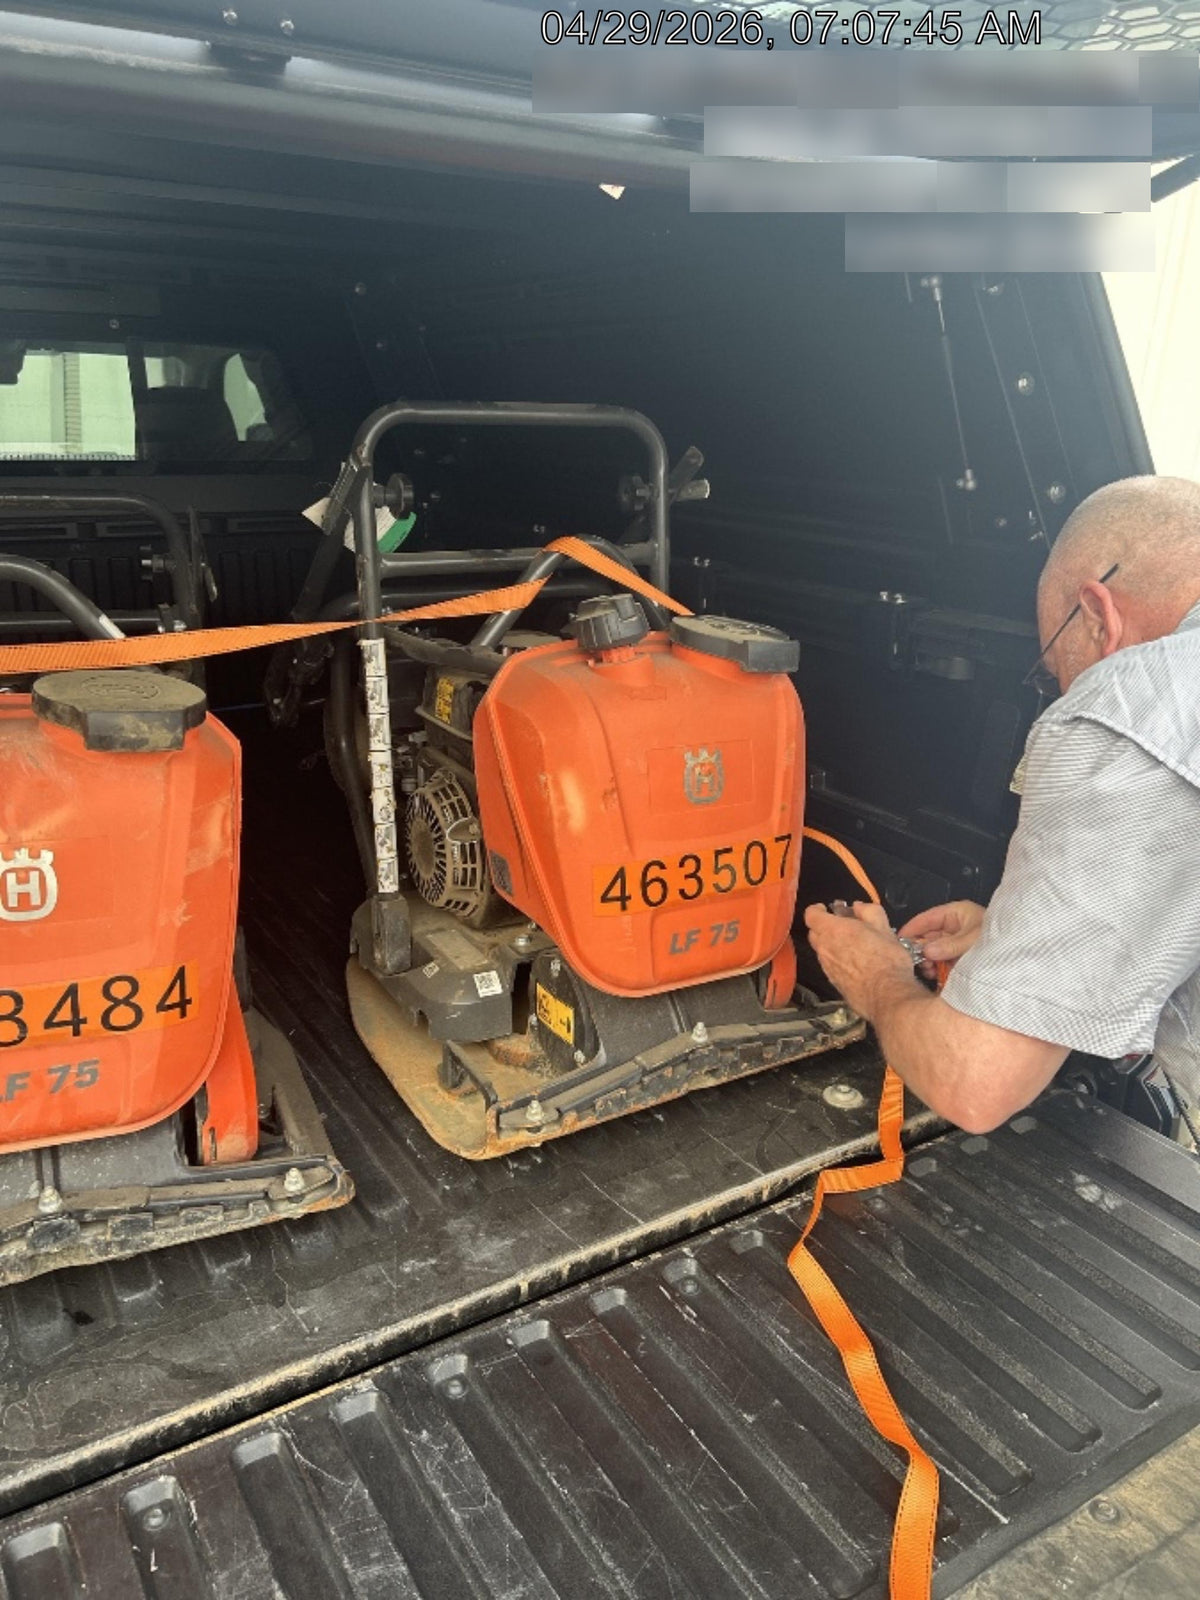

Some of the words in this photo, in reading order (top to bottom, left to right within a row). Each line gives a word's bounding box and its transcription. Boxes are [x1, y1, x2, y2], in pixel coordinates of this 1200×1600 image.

[600, 833, 793, 911] 463507
[669, 929, 701, 956] LF
[710, 920, 741, 947] 75
[0, 1071, 31, 1104] F
[48, 1059, 100, 1095] 75
